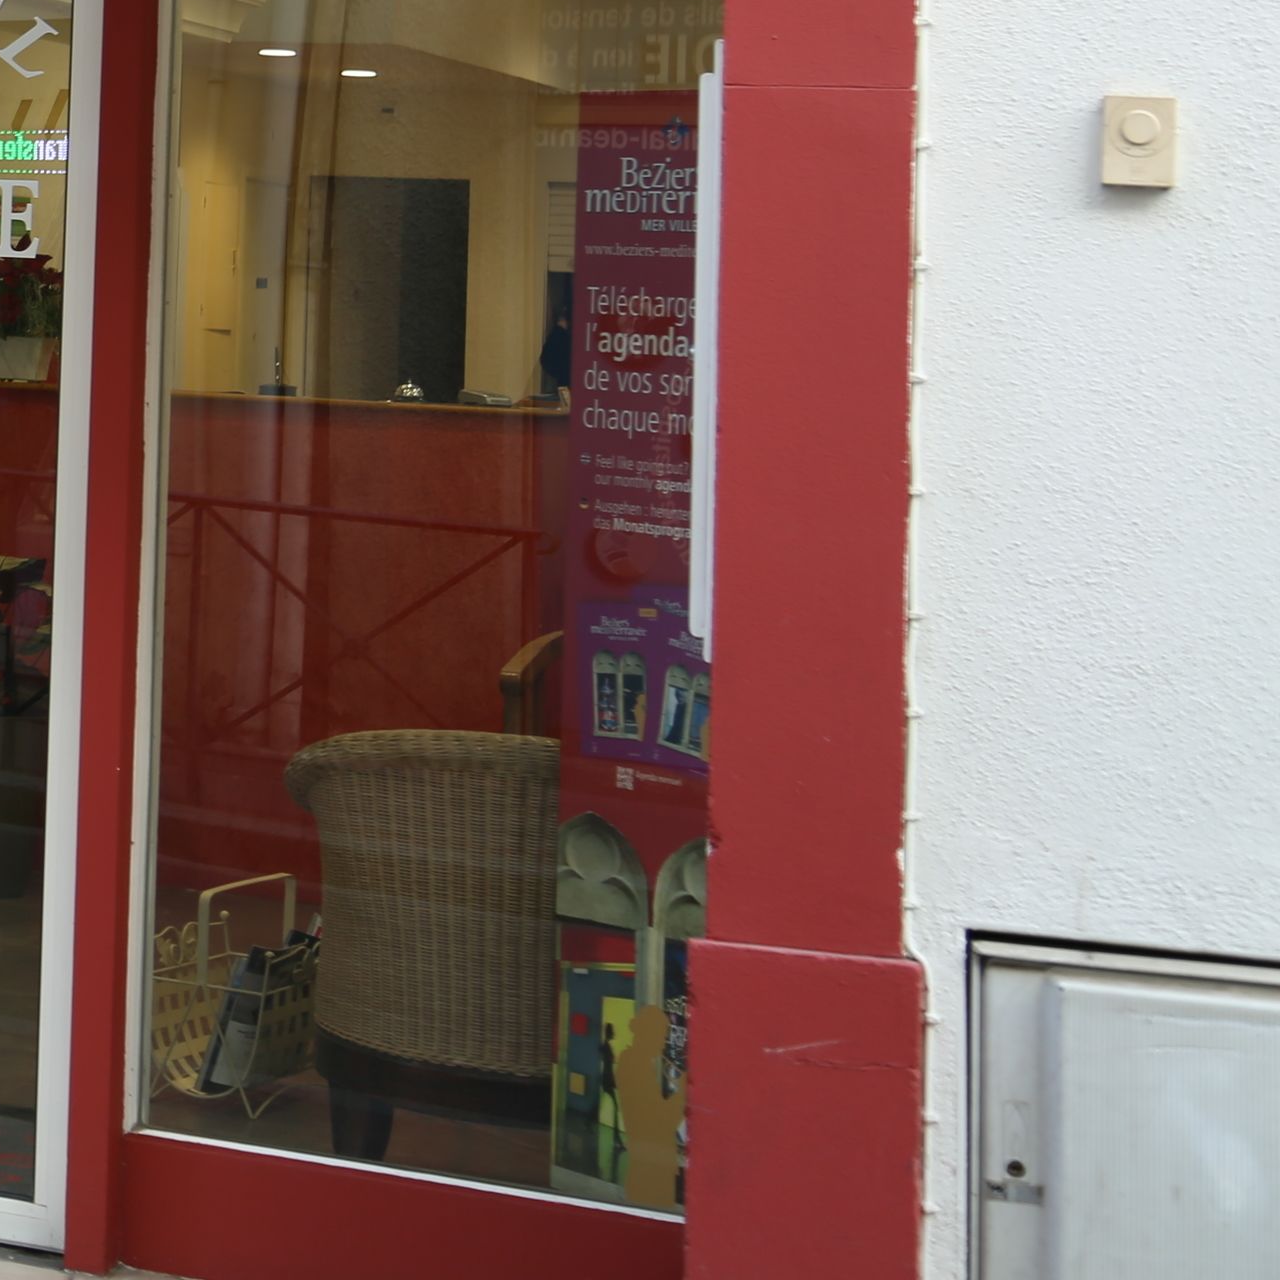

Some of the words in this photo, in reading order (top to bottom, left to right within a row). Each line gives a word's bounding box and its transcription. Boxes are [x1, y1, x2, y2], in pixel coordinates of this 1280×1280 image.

[640, 218, 666, 232] MER
[584, 365, 610, 392] de
[617, 370, 653, 395] vos
[582, 399, 660, 439] chaque
